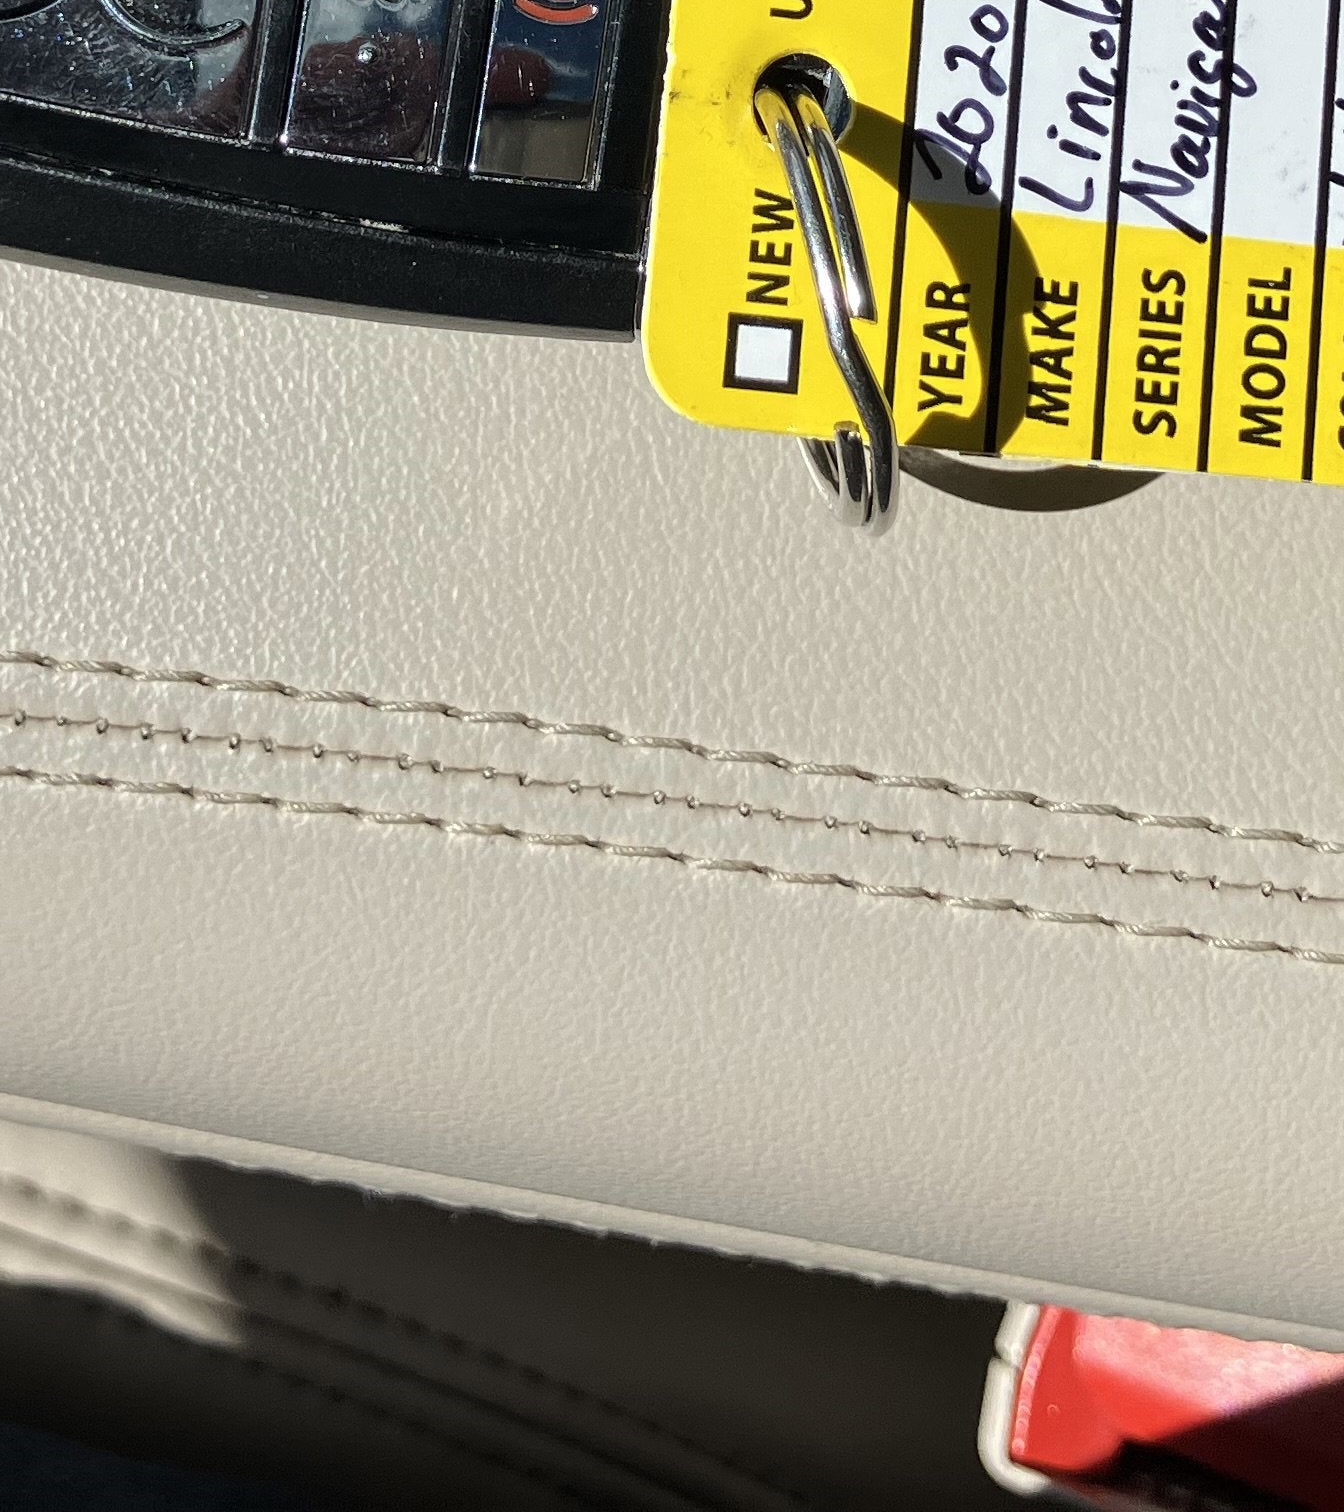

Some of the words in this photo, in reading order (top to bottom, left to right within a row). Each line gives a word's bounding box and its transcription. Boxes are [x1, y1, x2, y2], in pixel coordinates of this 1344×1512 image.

[913, 3, 1010, 196] 2020
[747, 187, 795, 307] NEW
[917, 278, 972, 412] YEAR
[1026, 276, 1080, 426] MAKE
[1134, 267, 1187, 438] SERIES
[1240, 265, 1293, 448] MODEL
